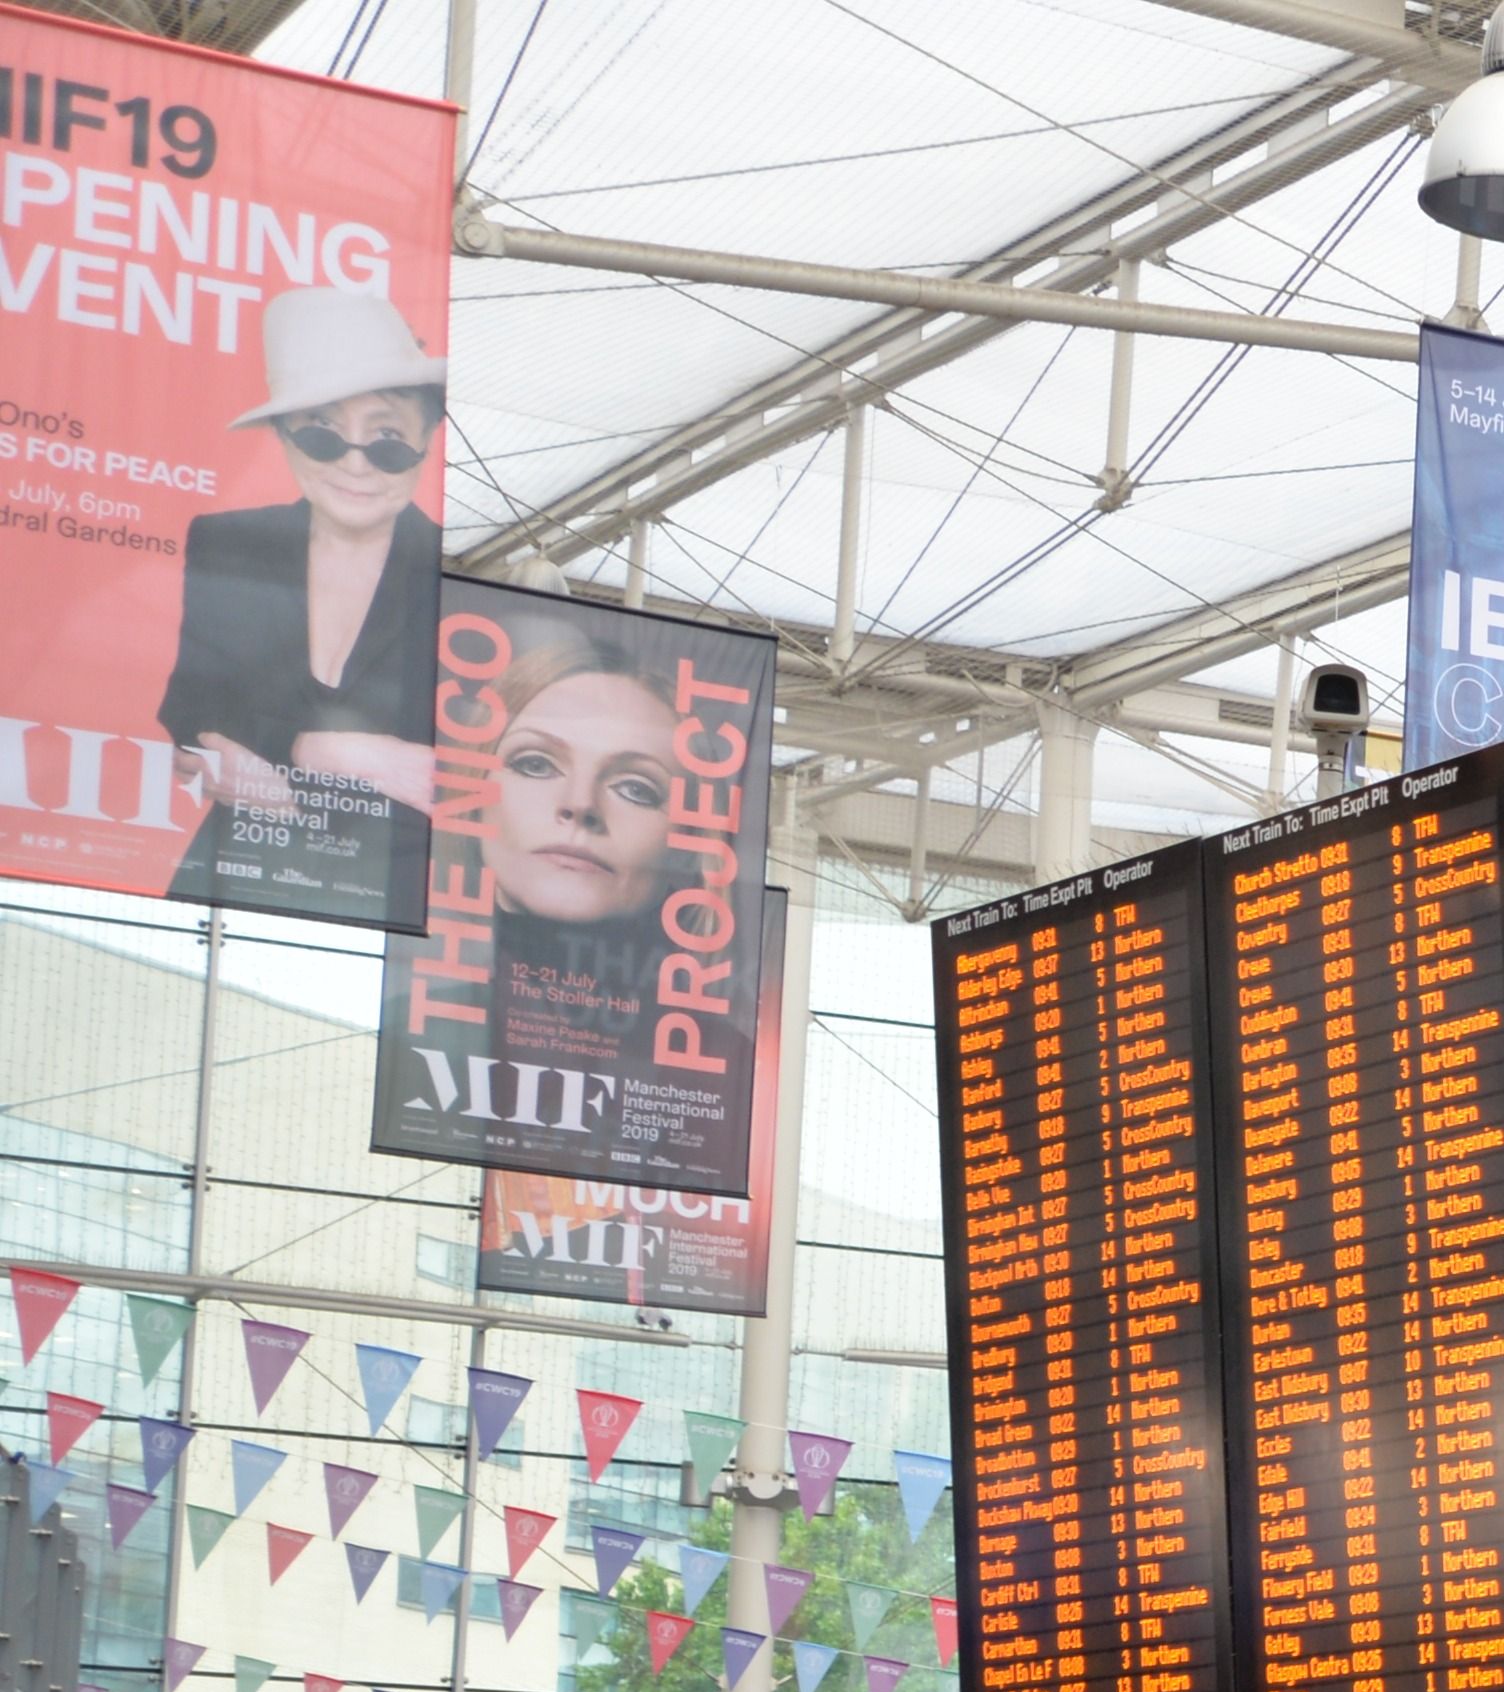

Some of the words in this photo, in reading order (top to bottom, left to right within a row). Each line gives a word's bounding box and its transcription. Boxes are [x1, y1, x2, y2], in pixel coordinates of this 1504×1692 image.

[0, 66, 217, 180] IF19
[25, 436, 96, 475] FOR
[103, 450, 218, 497] PEACE
[8, 479, 71, 512] July,
[78, 491, 142, 522] 6pm
[56, 515, 178, 557] Gardens
[434, 612, 513, 841] NICO
[653, 657, 750, 1075] PROJECT
[409, 859, 496, 1035] THE
[510, 980, 542, 999] The
[606, 997, 641, 1015] Hall
[561, 971, 597, 992] July
[622, 1094, 726, 1121] International
[623, 1077, 722, 1105] Manchester
[620, 1125, 660, 1143] 2019
[621, 1109, 684, 1131] Festival
